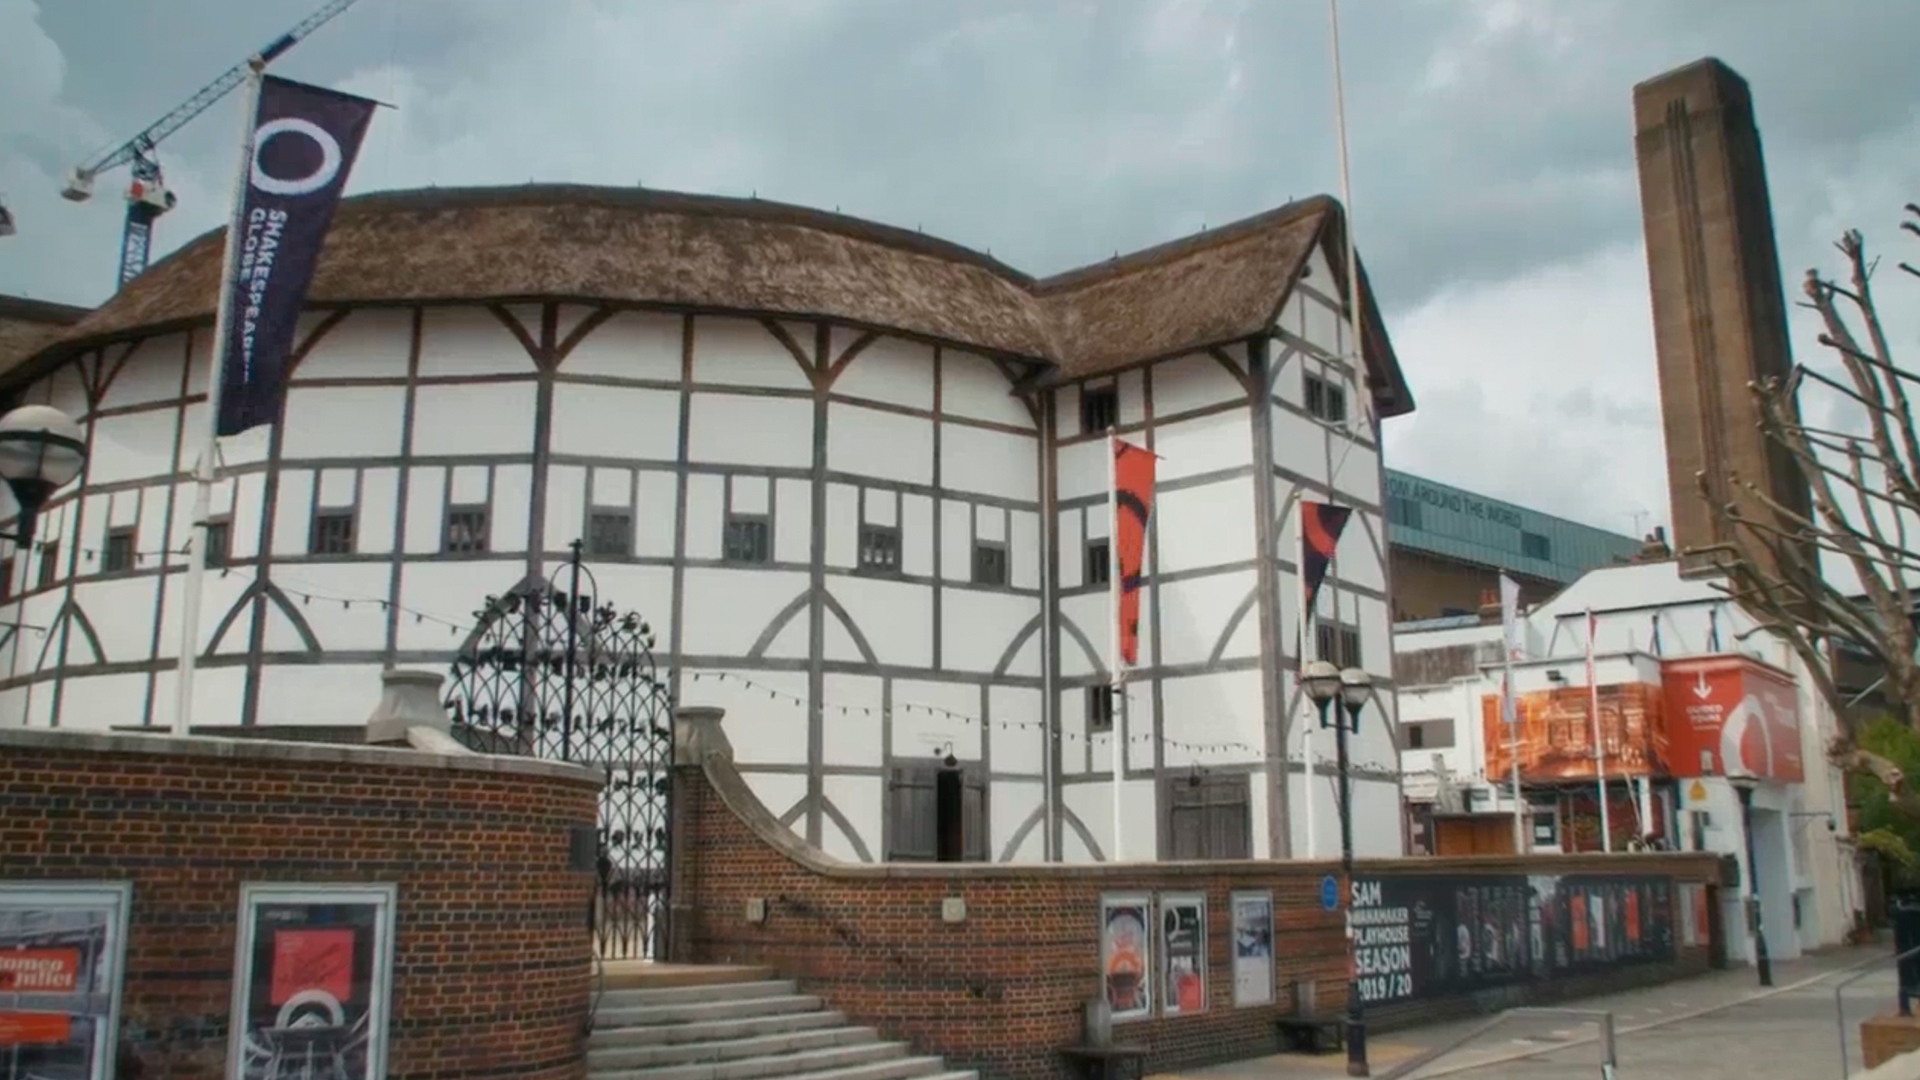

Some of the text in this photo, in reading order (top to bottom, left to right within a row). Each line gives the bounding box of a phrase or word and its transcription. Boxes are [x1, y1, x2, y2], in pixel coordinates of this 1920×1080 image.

[240, 207, 267, 283] GLOBE
[1412, 482, 1461, 513] AROUND
[1461, 497, 1485, 519] THE
[1487, 505, 1522, 529] WORLD
[1351, 881, 1382, 908] SAM
[1352, 907, 1409, 926] WANAMAKER
[1354, 925, 1410, 946] PLAYHOUSE
[1355, 944, 1412, 975] SEASON
